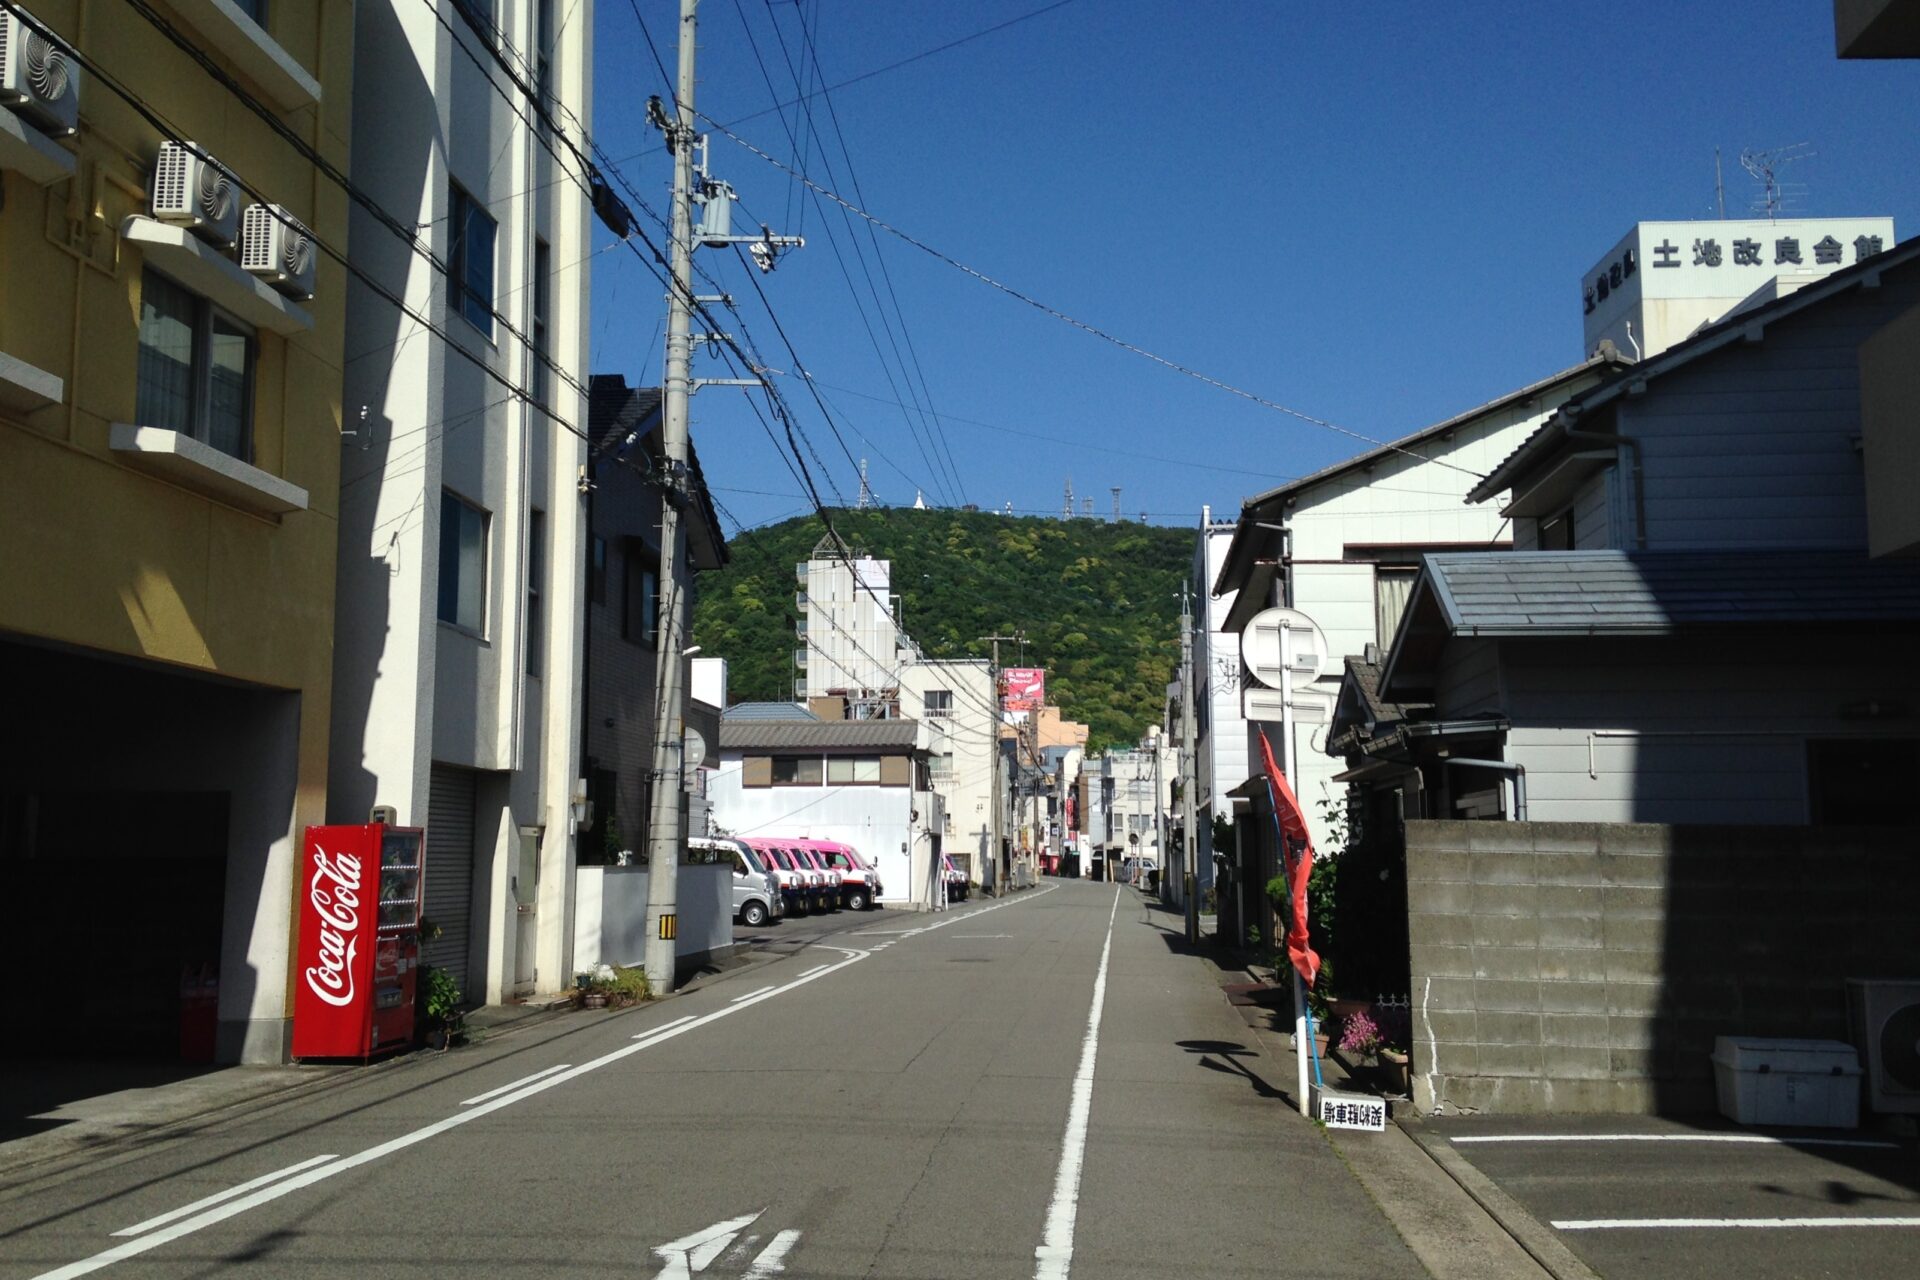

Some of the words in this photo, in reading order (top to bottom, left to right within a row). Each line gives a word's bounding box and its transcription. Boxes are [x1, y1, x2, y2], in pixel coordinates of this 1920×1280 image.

[1652, 235, 1883, 268] 土地改良会館
[306, 844, 361, 1006] Coca-Cola
[1324, 1101, 1382, 1127] 契約駐車場
